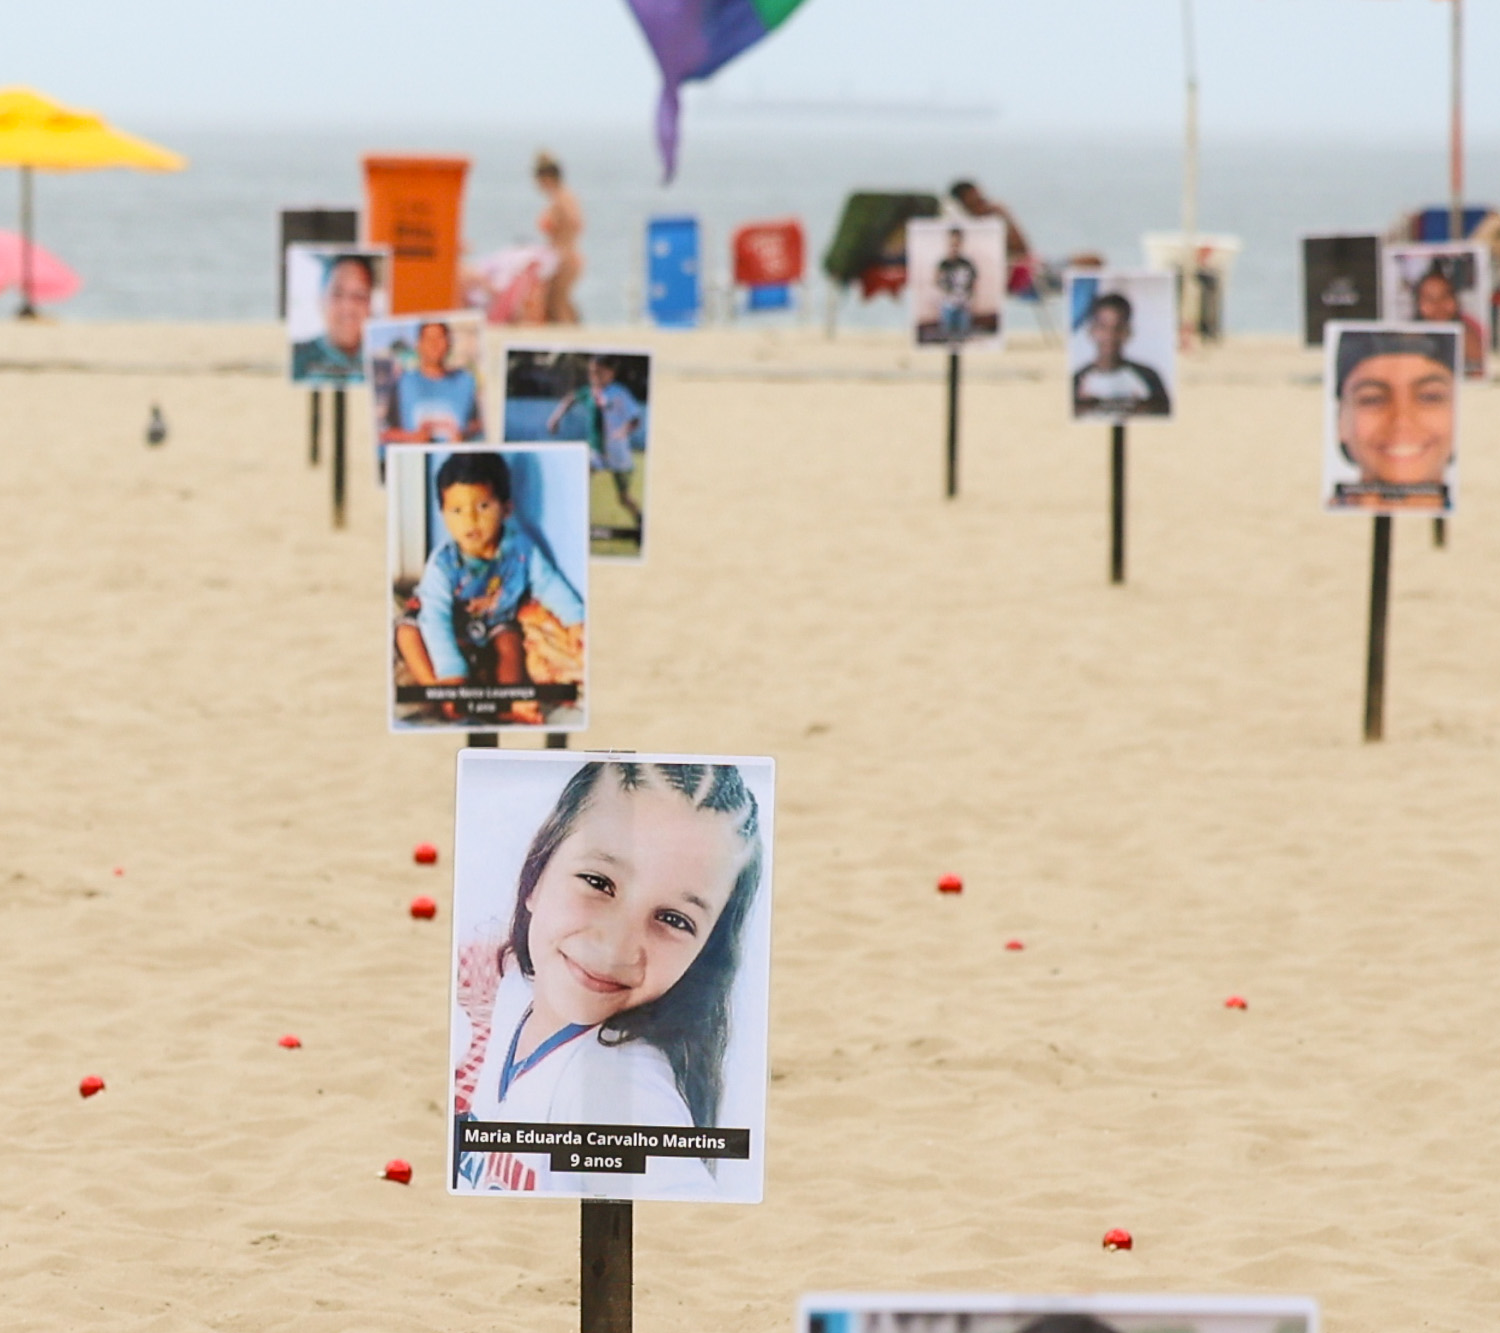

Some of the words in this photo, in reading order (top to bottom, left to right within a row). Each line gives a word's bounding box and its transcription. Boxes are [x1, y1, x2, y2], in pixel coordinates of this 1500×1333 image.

[464, 1128, 512, 1144] Maria
[515, 1129, 583, 1146] Eduarda
[586, 1131, 659, 1148] Carvalho
[662, 1133, 726, 1150] Martins
[569, 1153, 580, 1168] 9
[583, 1155, 623, 1168] anos
